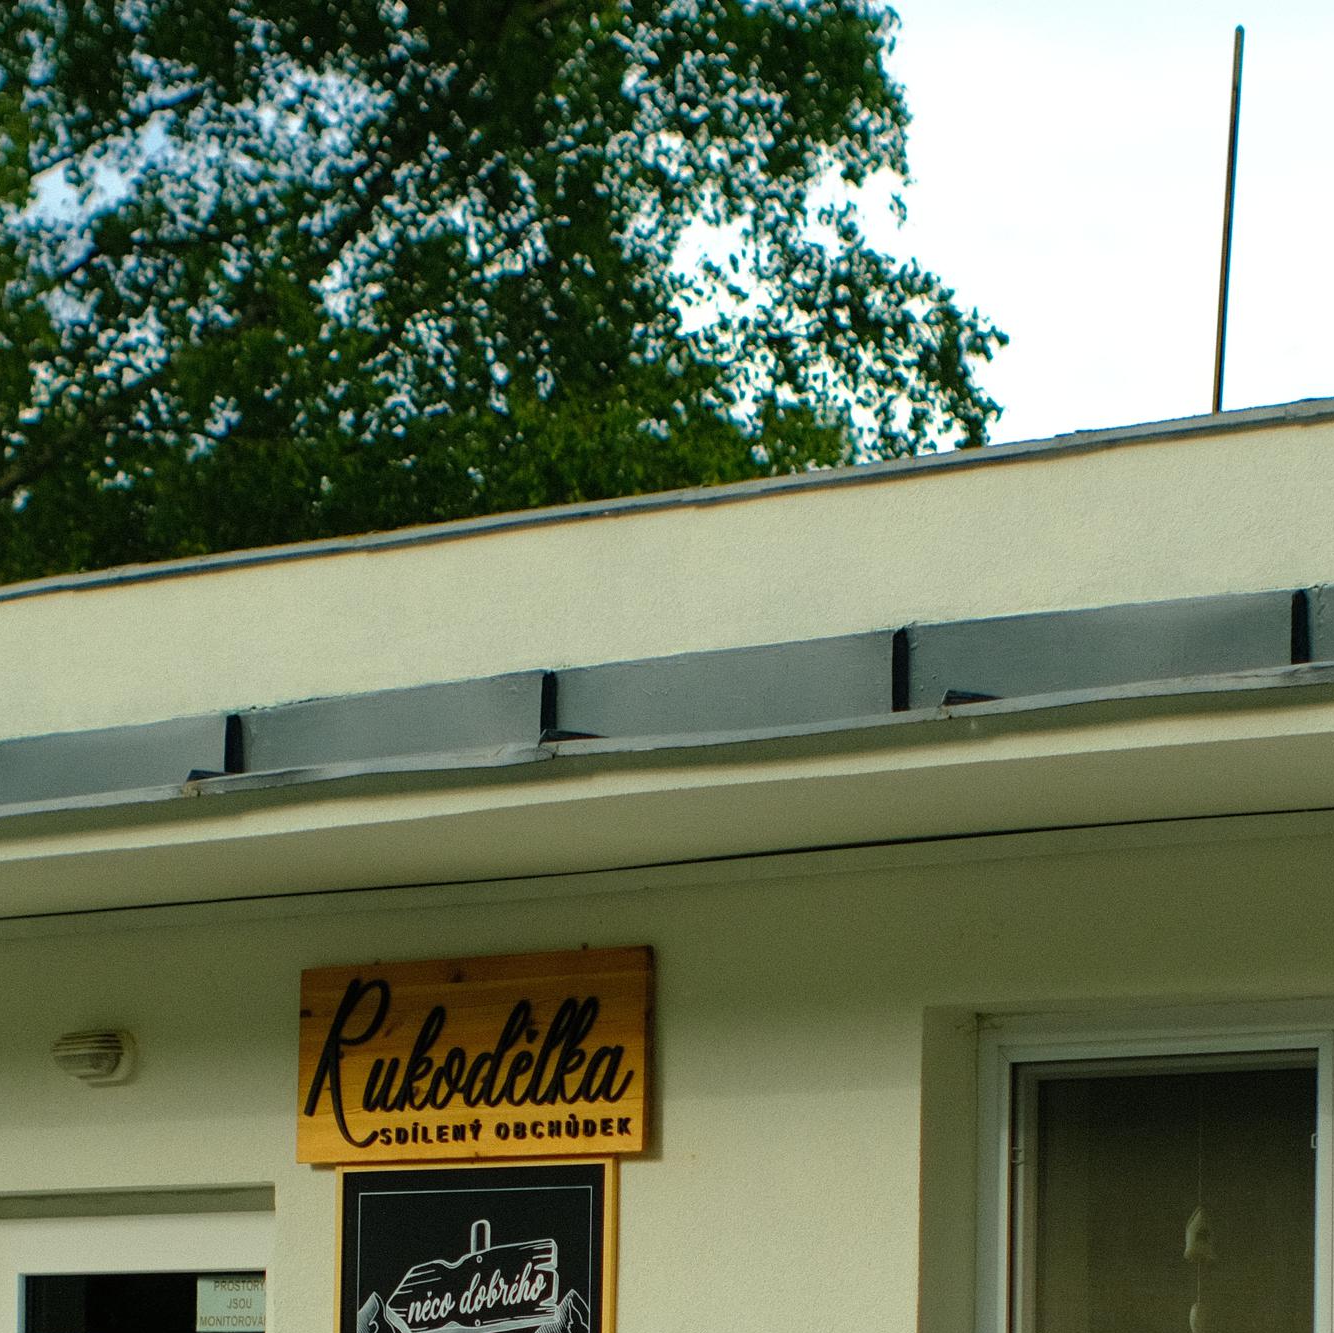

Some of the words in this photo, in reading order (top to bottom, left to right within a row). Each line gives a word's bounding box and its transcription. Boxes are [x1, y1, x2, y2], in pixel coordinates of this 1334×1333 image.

[304, 977, 635, 1149] Rukodělka
[379, 1119, 483, 1146] SDÍLENÝ
[495, 1113, 632, 1141] OBCHŮDEK
[213, 1280, 265, 1291] PROSTORY
[407, 1291, 456, 1324] něco
[459, 1262, 547, 1314] dobrého
[227, 1298, 252, 1309] JSOU
